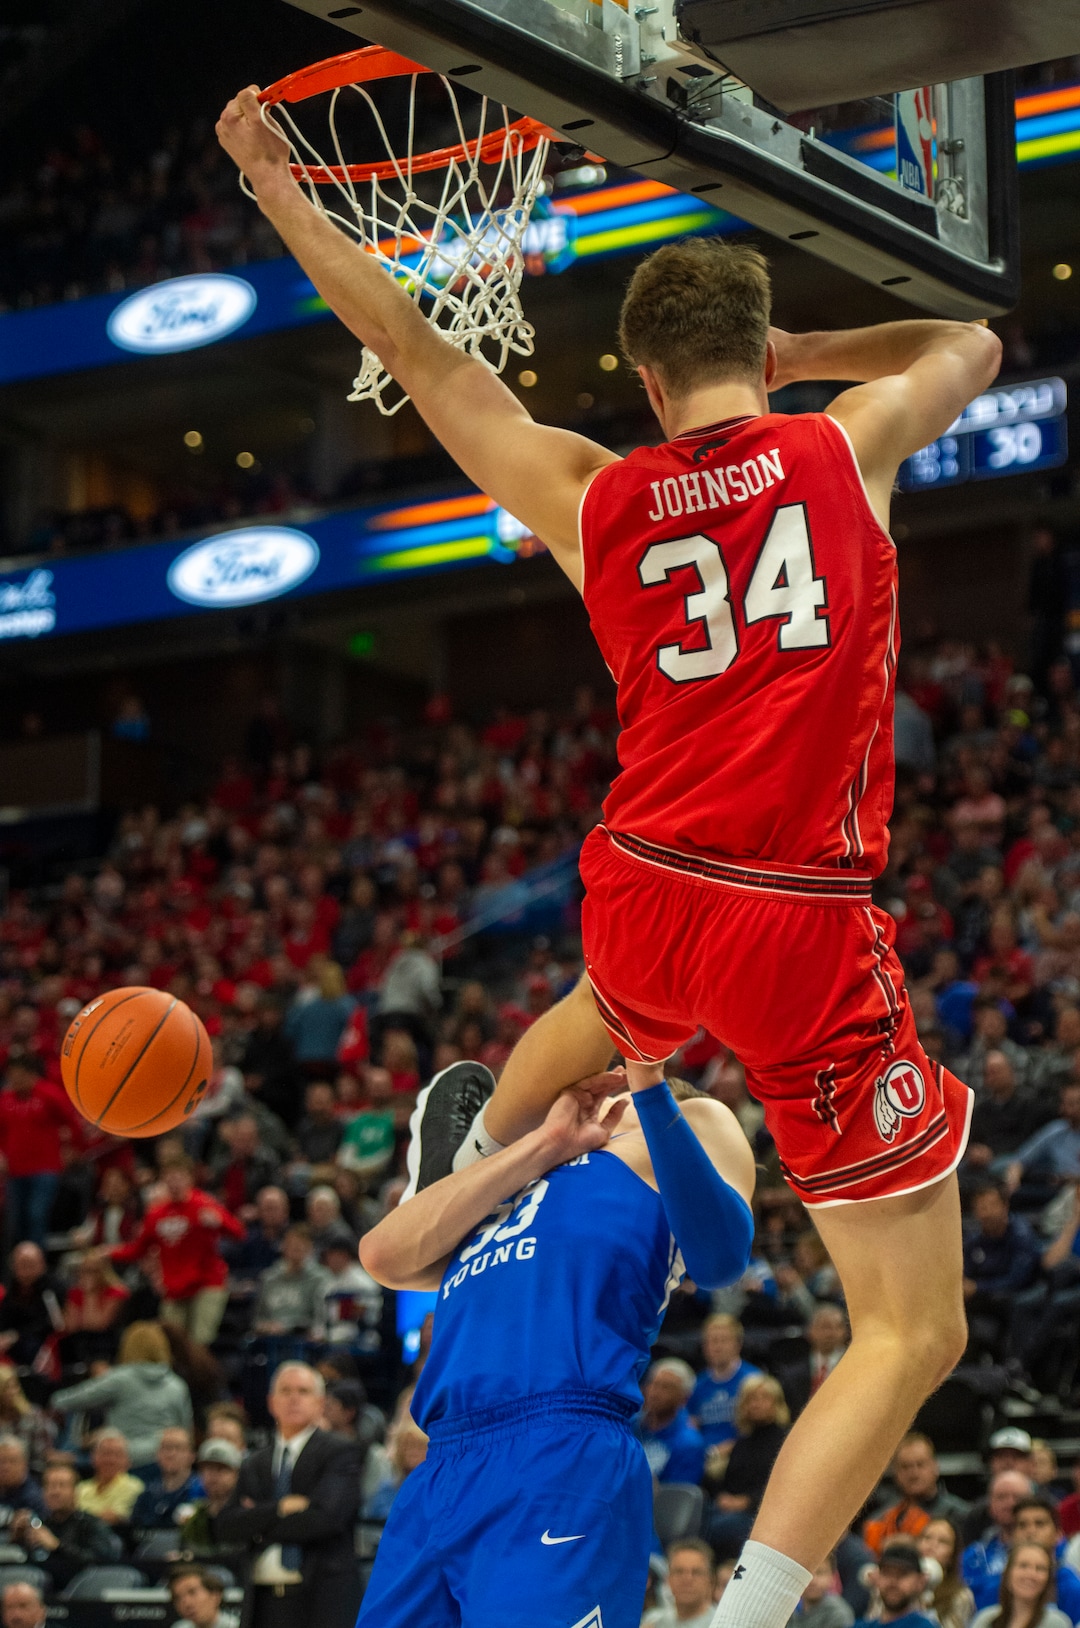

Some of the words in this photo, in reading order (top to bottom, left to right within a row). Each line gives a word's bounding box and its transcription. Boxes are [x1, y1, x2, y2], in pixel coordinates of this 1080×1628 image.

[901, 157, 921, 191] NBA
[648, 447, 786, 522] JOHNSON
[637, 501, 832, 685] 34
[889, 1069, 921, 1110] U
[459, 1178, 550, 1263] 33
[443, 1236, 537, 1301] YOUNG
